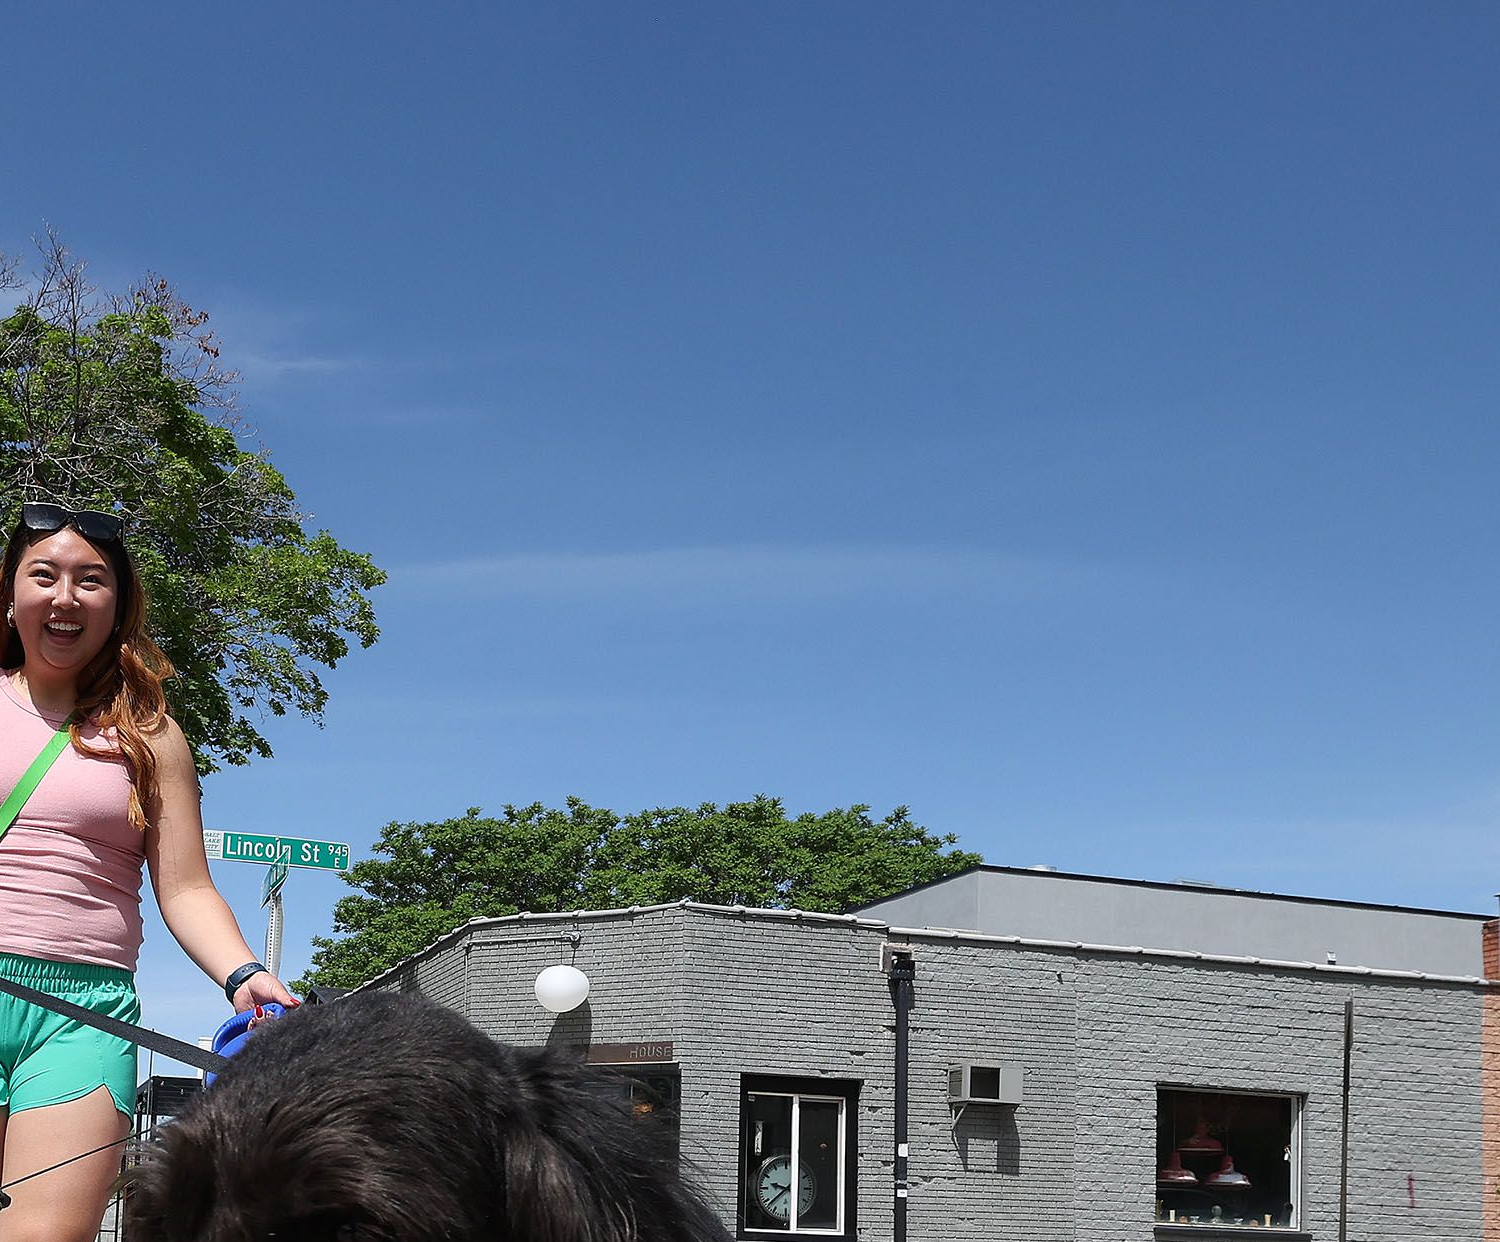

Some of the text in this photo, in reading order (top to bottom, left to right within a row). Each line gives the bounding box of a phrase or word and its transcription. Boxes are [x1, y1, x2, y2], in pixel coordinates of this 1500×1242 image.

[226, 836, 348, 863] Lincoln St 945
[334, 857, 340, 868] E
[629, 1045, 672, 1059] HOUSE
